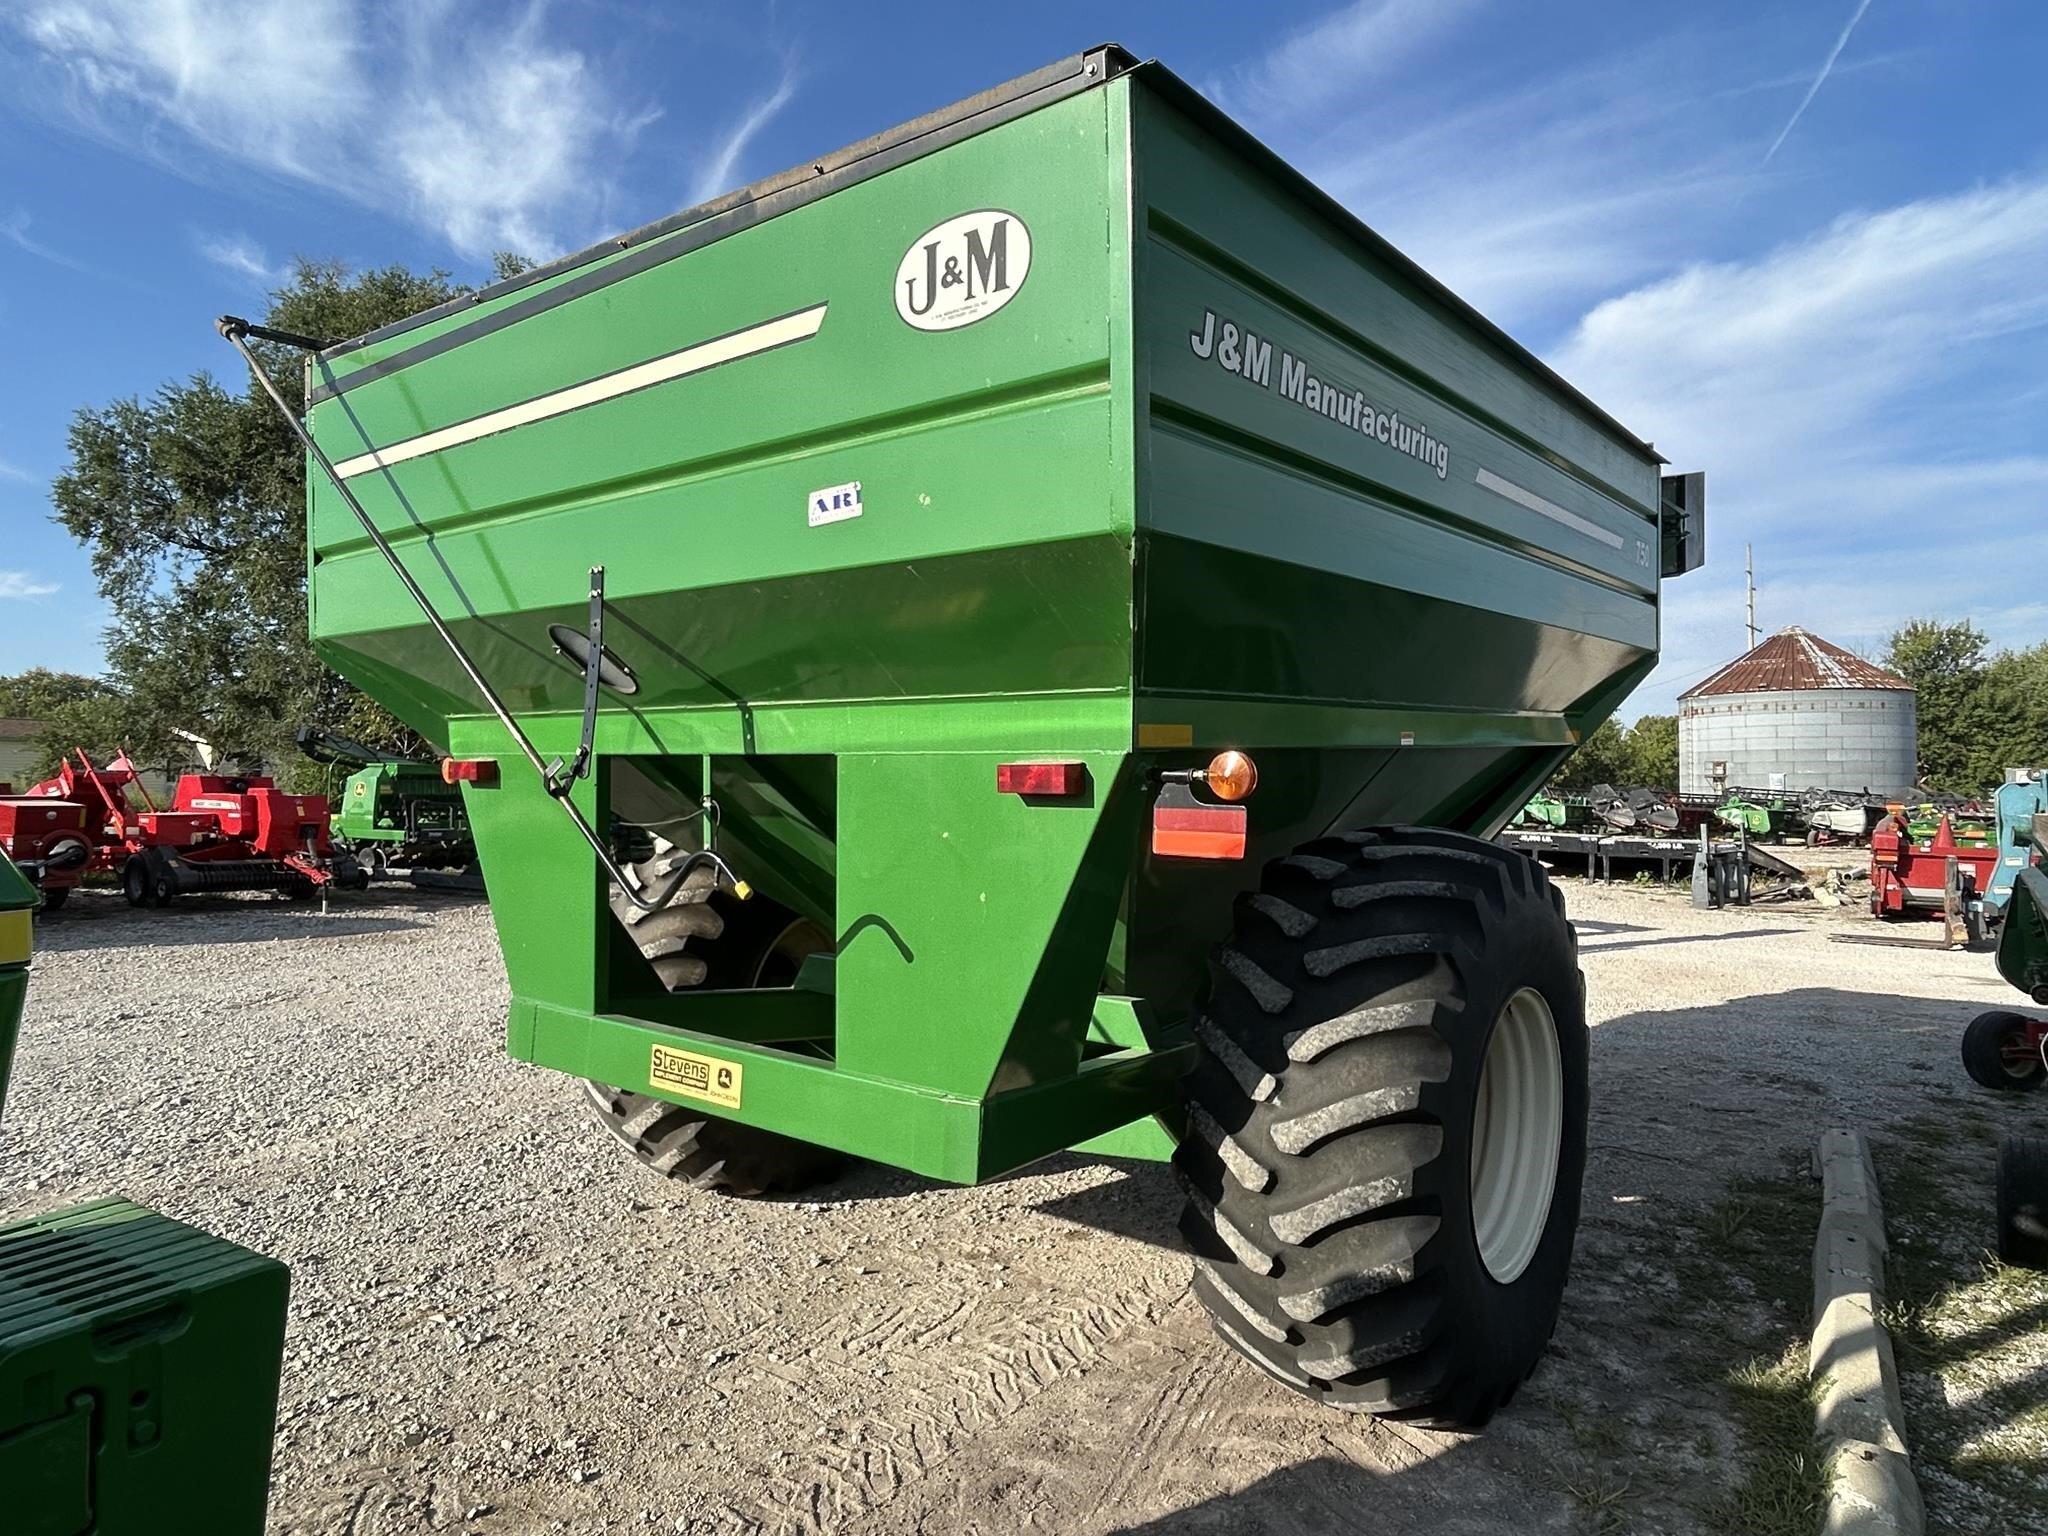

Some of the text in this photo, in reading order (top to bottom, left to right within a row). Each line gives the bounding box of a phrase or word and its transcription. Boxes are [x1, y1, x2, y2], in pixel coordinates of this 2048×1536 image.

[905, 218, 1010, 316] J&M
[1190, 311, 1450, 481] J&M Manufacturing
[653, 1048, 708, 1079] Stevens
